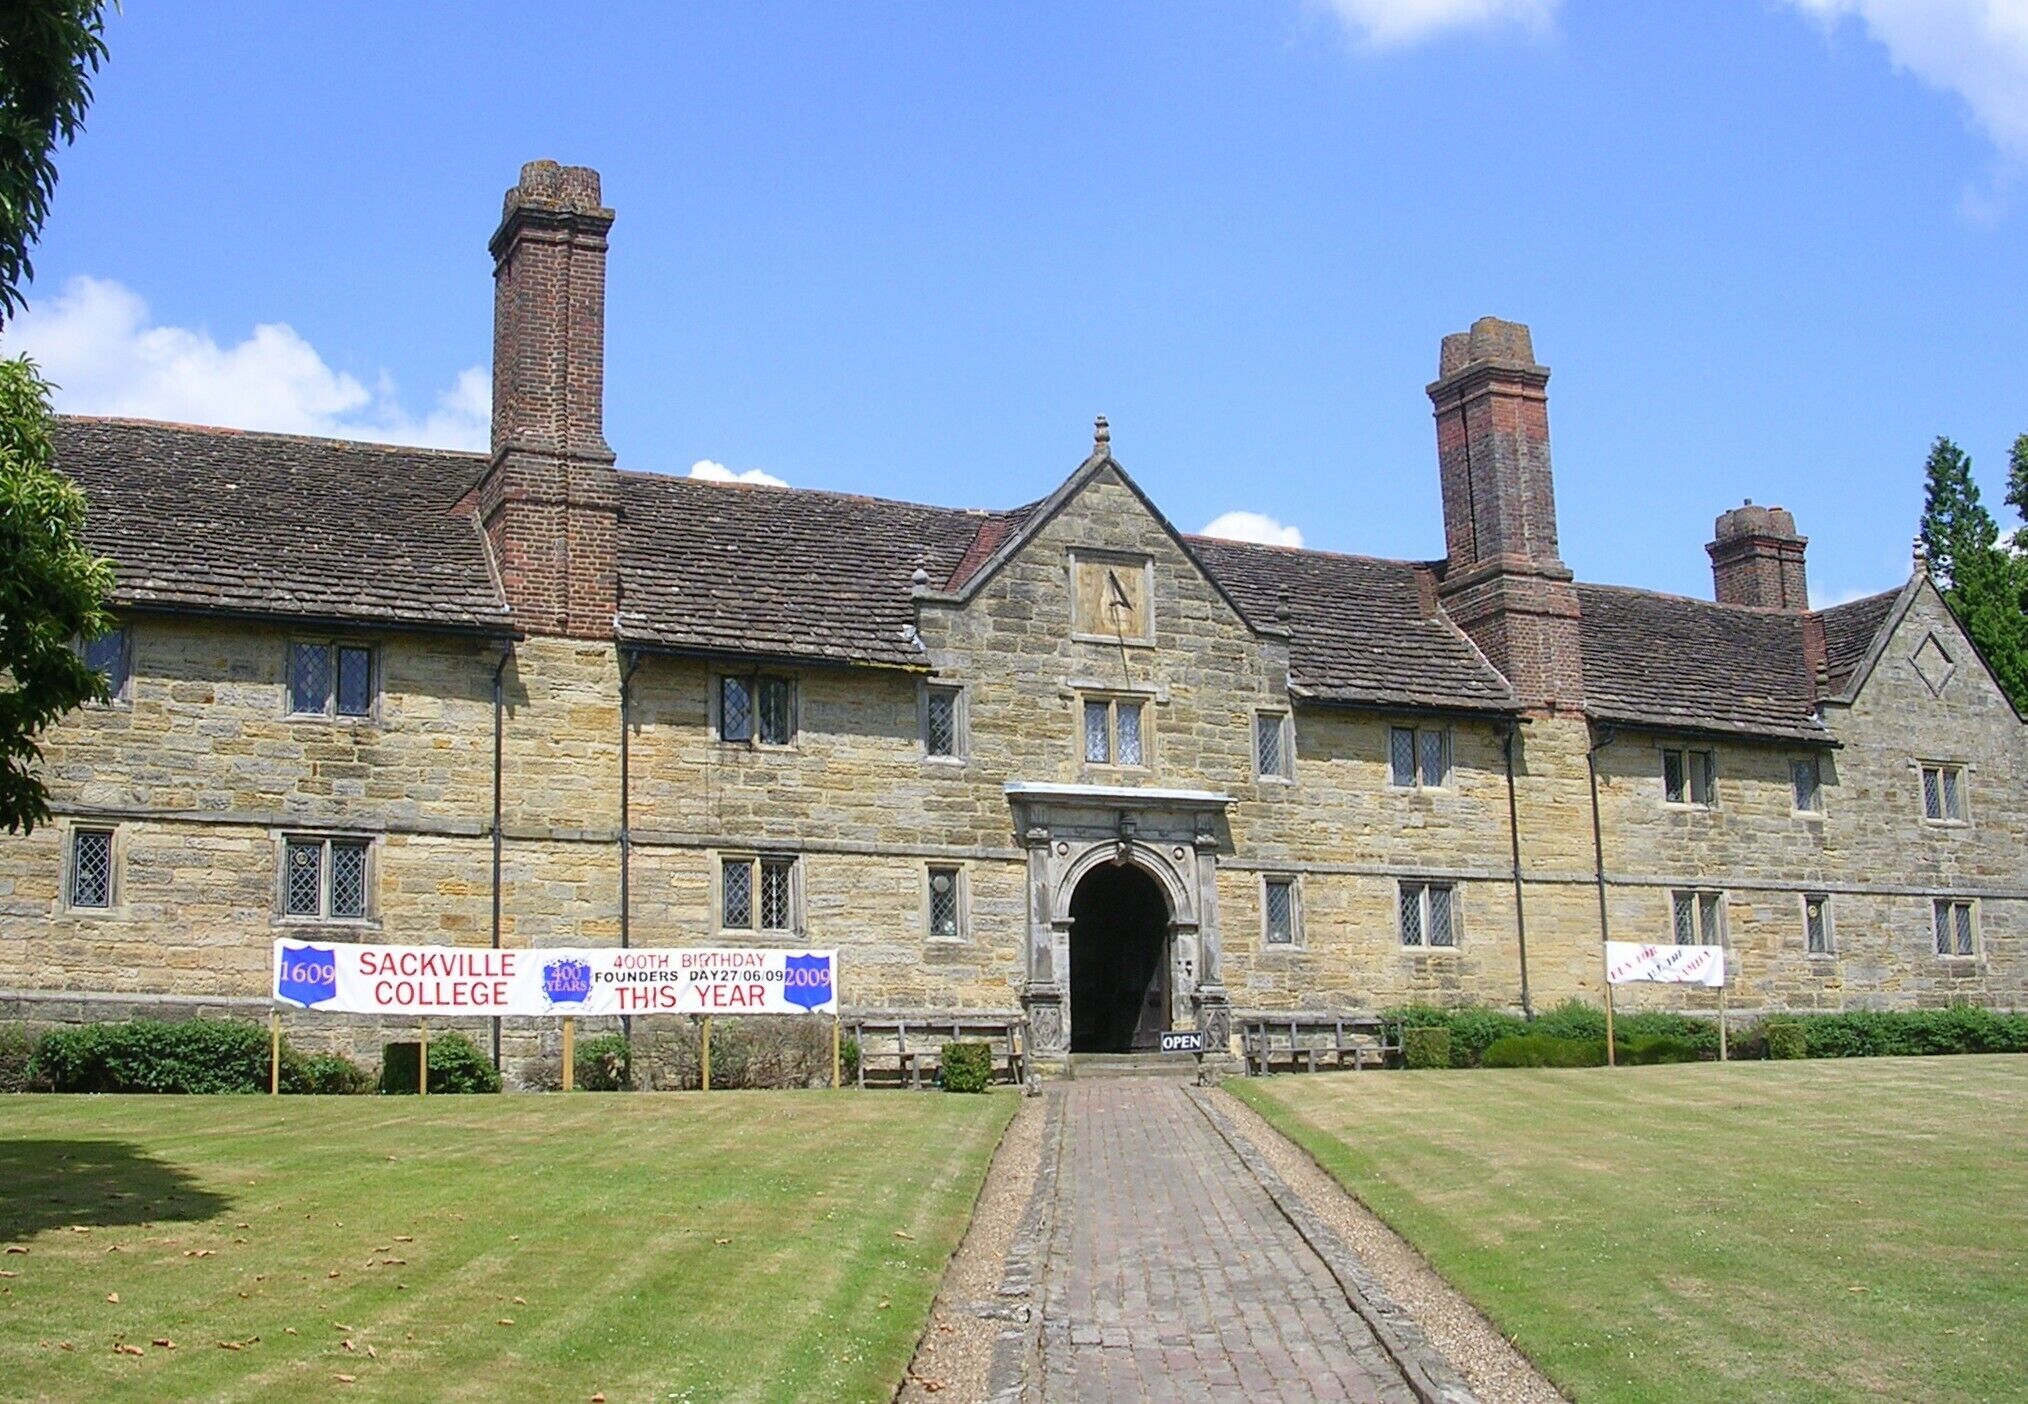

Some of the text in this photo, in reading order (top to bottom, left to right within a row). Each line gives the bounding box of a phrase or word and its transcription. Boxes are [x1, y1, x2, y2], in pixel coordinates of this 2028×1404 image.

[360, 952, 516, 977] SACKVILLE
[614, 953, 766, 969] 400TH BIRTHDAY
[280, 961, 336, 985] 1609
[551, 966, 581, 980] 400
[595, 971, 679, 982] FOUNDERS
[785, 968, 831, 987] 2009
[375, 981, 508, 1006] COLLEGE
[546, 980, 588, 992] YEARS
[615, 984, 765, 1010] THIS YEAR
[1163, 1035, 1200, 1049] OPEN
